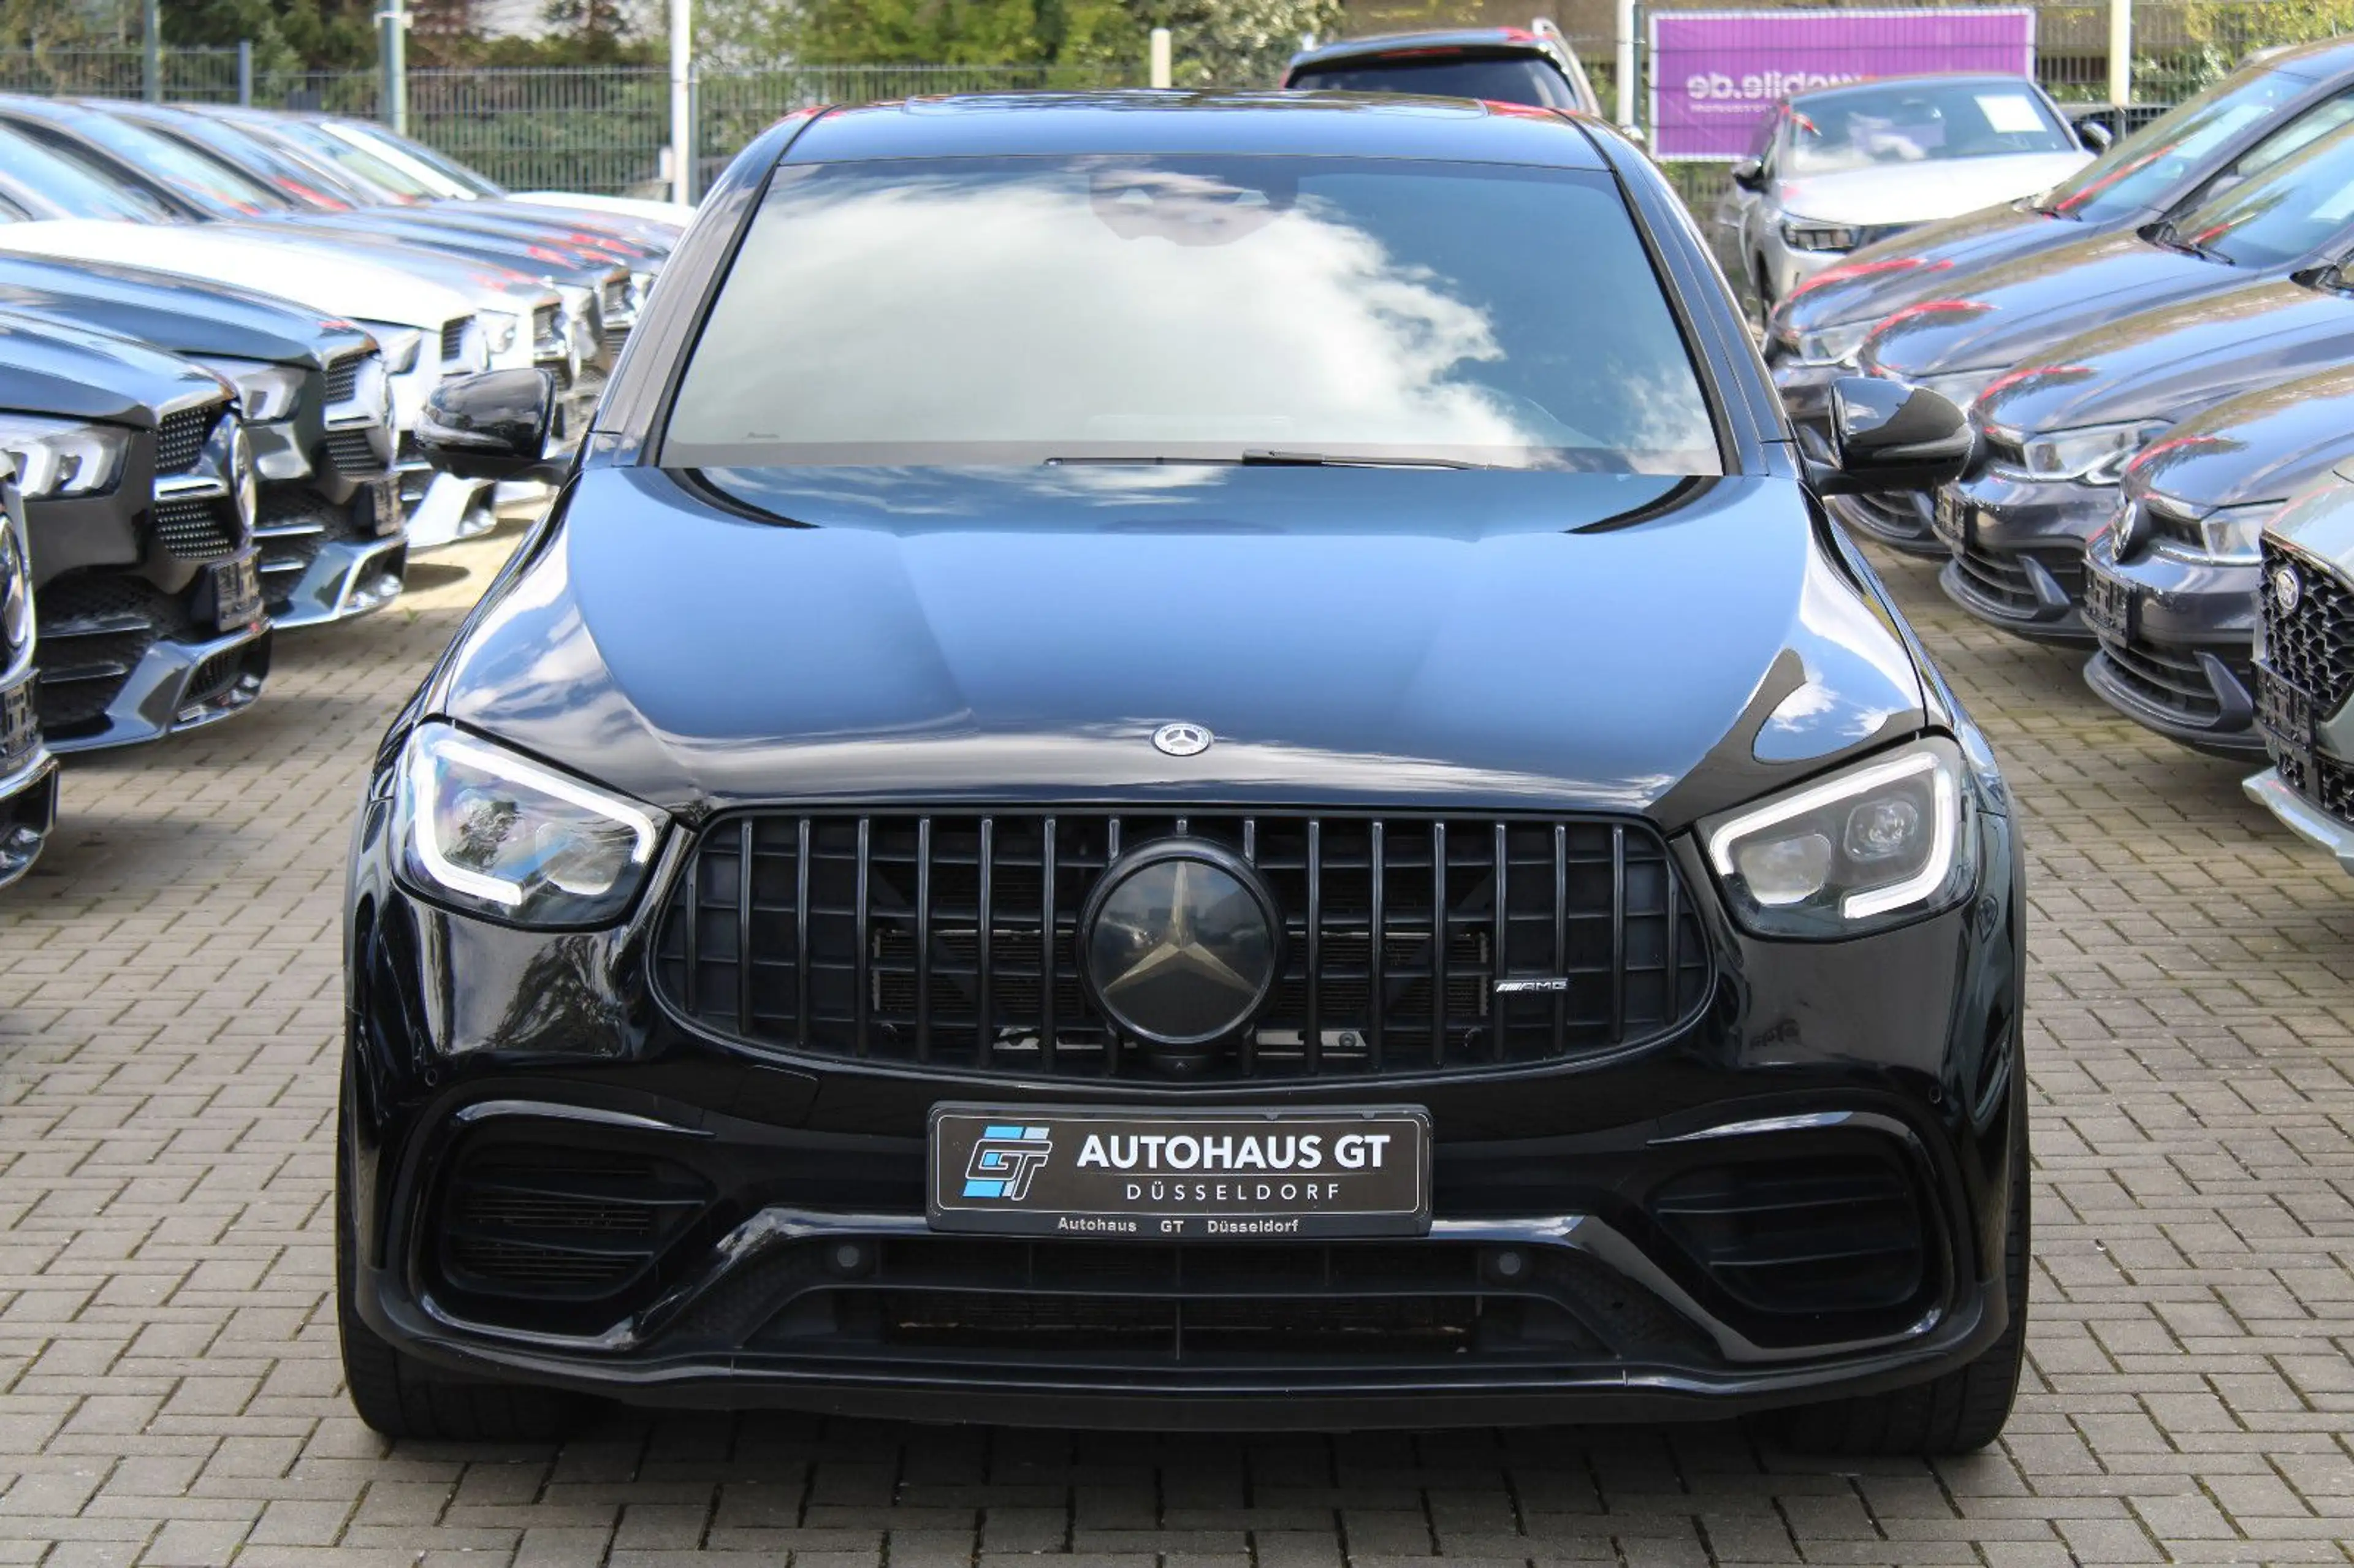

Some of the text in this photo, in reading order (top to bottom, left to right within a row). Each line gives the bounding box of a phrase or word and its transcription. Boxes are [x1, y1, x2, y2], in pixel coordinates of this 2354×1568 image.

[1076, 1134, 1391, 1169] AUTOHAUS GT
[965, 1138, 1053, 1201] GT
[1126, 1181, 1339, 1201] DÜSSELDORF
[1057, 1216, 1298, 1233] Autohaus GT Düsseldorf
